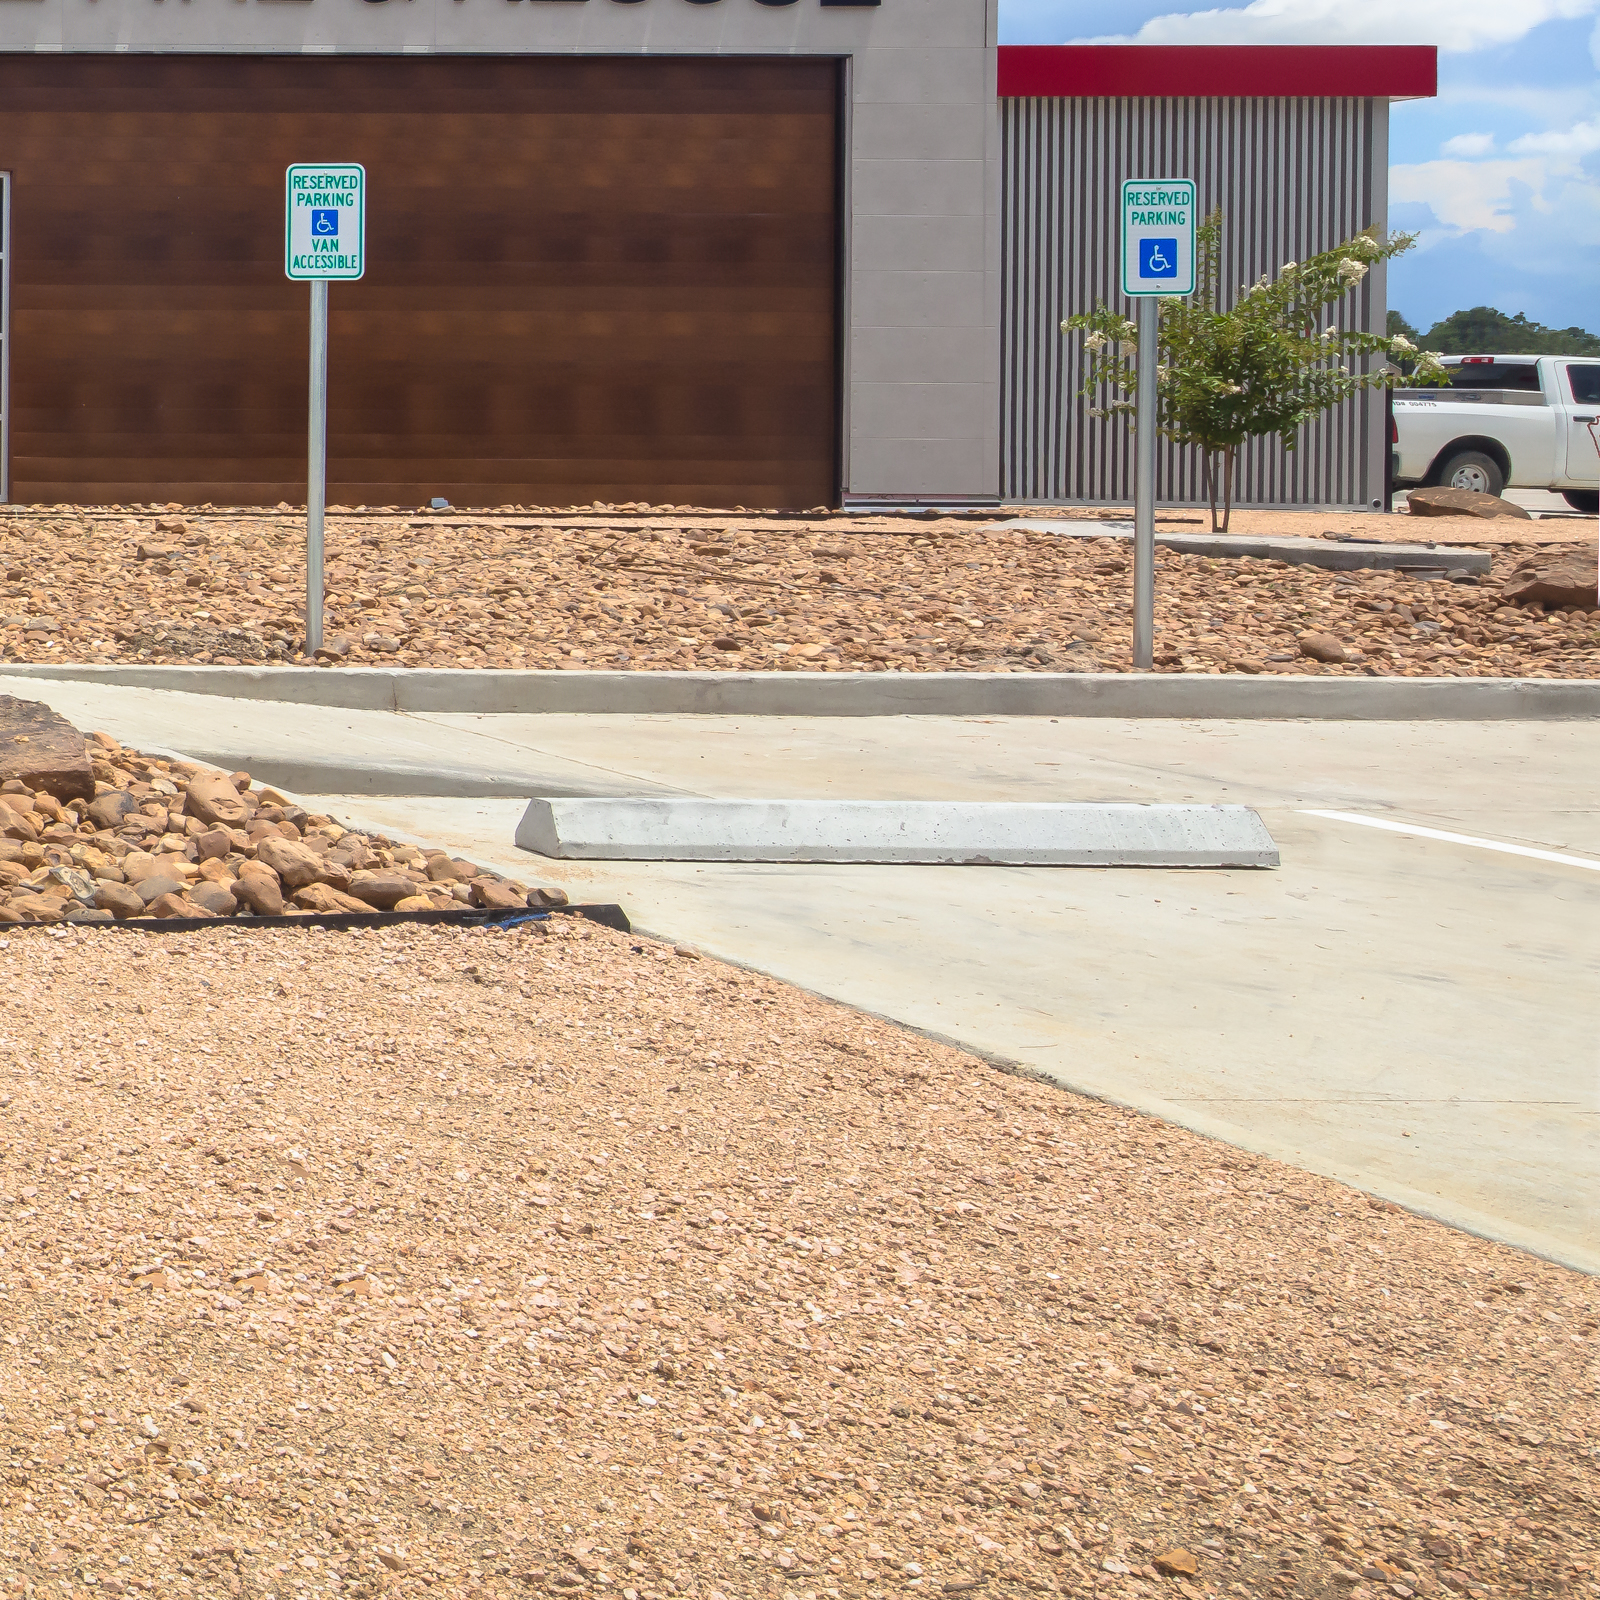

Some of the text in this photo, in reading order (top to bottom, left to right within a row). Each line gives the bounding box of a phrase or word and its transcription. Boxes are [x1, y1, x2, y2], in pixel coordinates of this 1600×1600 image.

[293, 175, 358, 189] RESERVED
[297, 192, 354, 207] PARKING
[1127, 191, 1190, 206] RESERVED
[1131, 211, 1186, 226] PARKING
[311, 238, 339, 253] VAN
[293, 254, 357, 269] ACCESSIBLE
